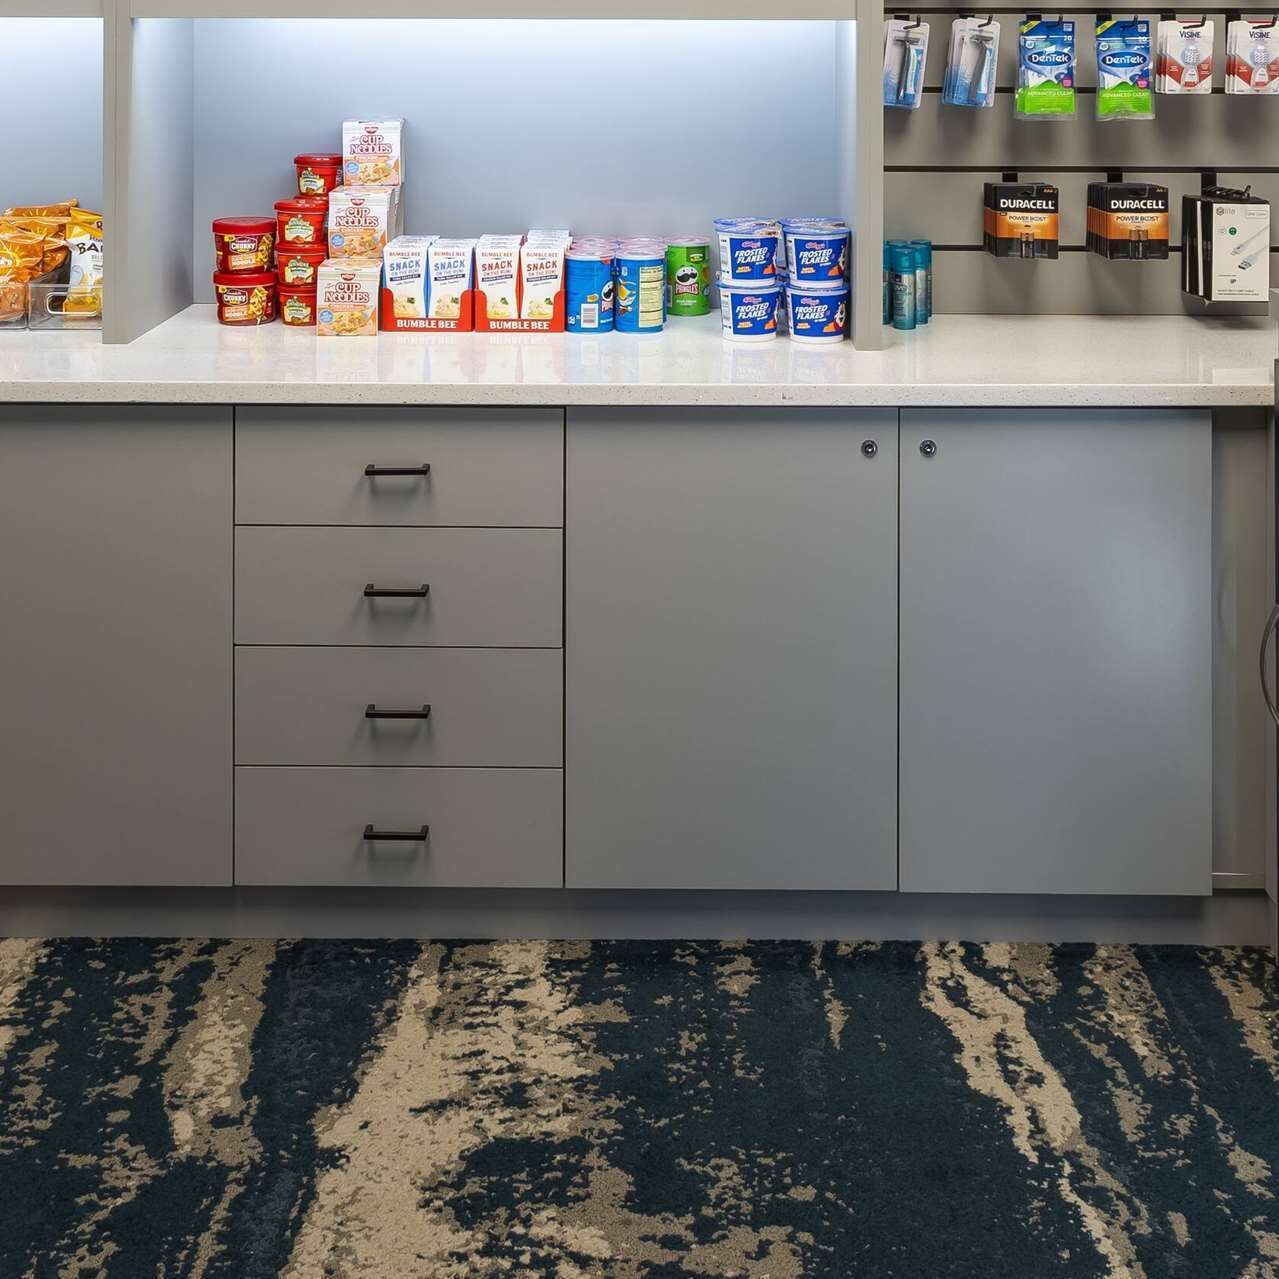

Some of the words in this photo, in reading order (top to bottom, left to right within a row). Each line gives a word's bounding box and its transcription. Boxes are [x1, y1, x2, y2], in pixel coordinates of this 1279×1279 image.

[1031, 54, 1069, 62] DenTek
[1105, 55, 1144, 64] DenTek
[360, 135, 383, 145] CUP
[350, 144, 392, 155] NOODLES
[1000, 198, 1055, 210] DURACELL
[1111, 199, 1165, 210] DURACELL
[345, 208, 370, 218] CUP
[335, 217, 379, 228] NOODLES
[735, 247, 768, 258] FROSTED
[799, 248, 833, 259] FROSTED
[737, 255, 765, 264] FLAKES
[801, 256, 830, 265] FLAKES
[389, 260, 421, 272] SNACK
[434, 260, 465, 272] SNACK
[481, 260, 513, 272] SNACK
[526, 260, 558, 272] SNACK
[335, 282, 361, 293] CUP
[324, 292, 370, 303] NOODLES
[736, 303, 769, 313] FROSTED
[795, 305, 828, 315] FROSTED
[738, 310, 767, 320] FLAKES
[797, 312, 825, 321] FLAKES
[397, 320, 437, 329] BUMBLE
[438, 320, 457, 329] BEE
[490, 321, 530, 330] BUMBLE
[531, 321, 550, 330] BEE
